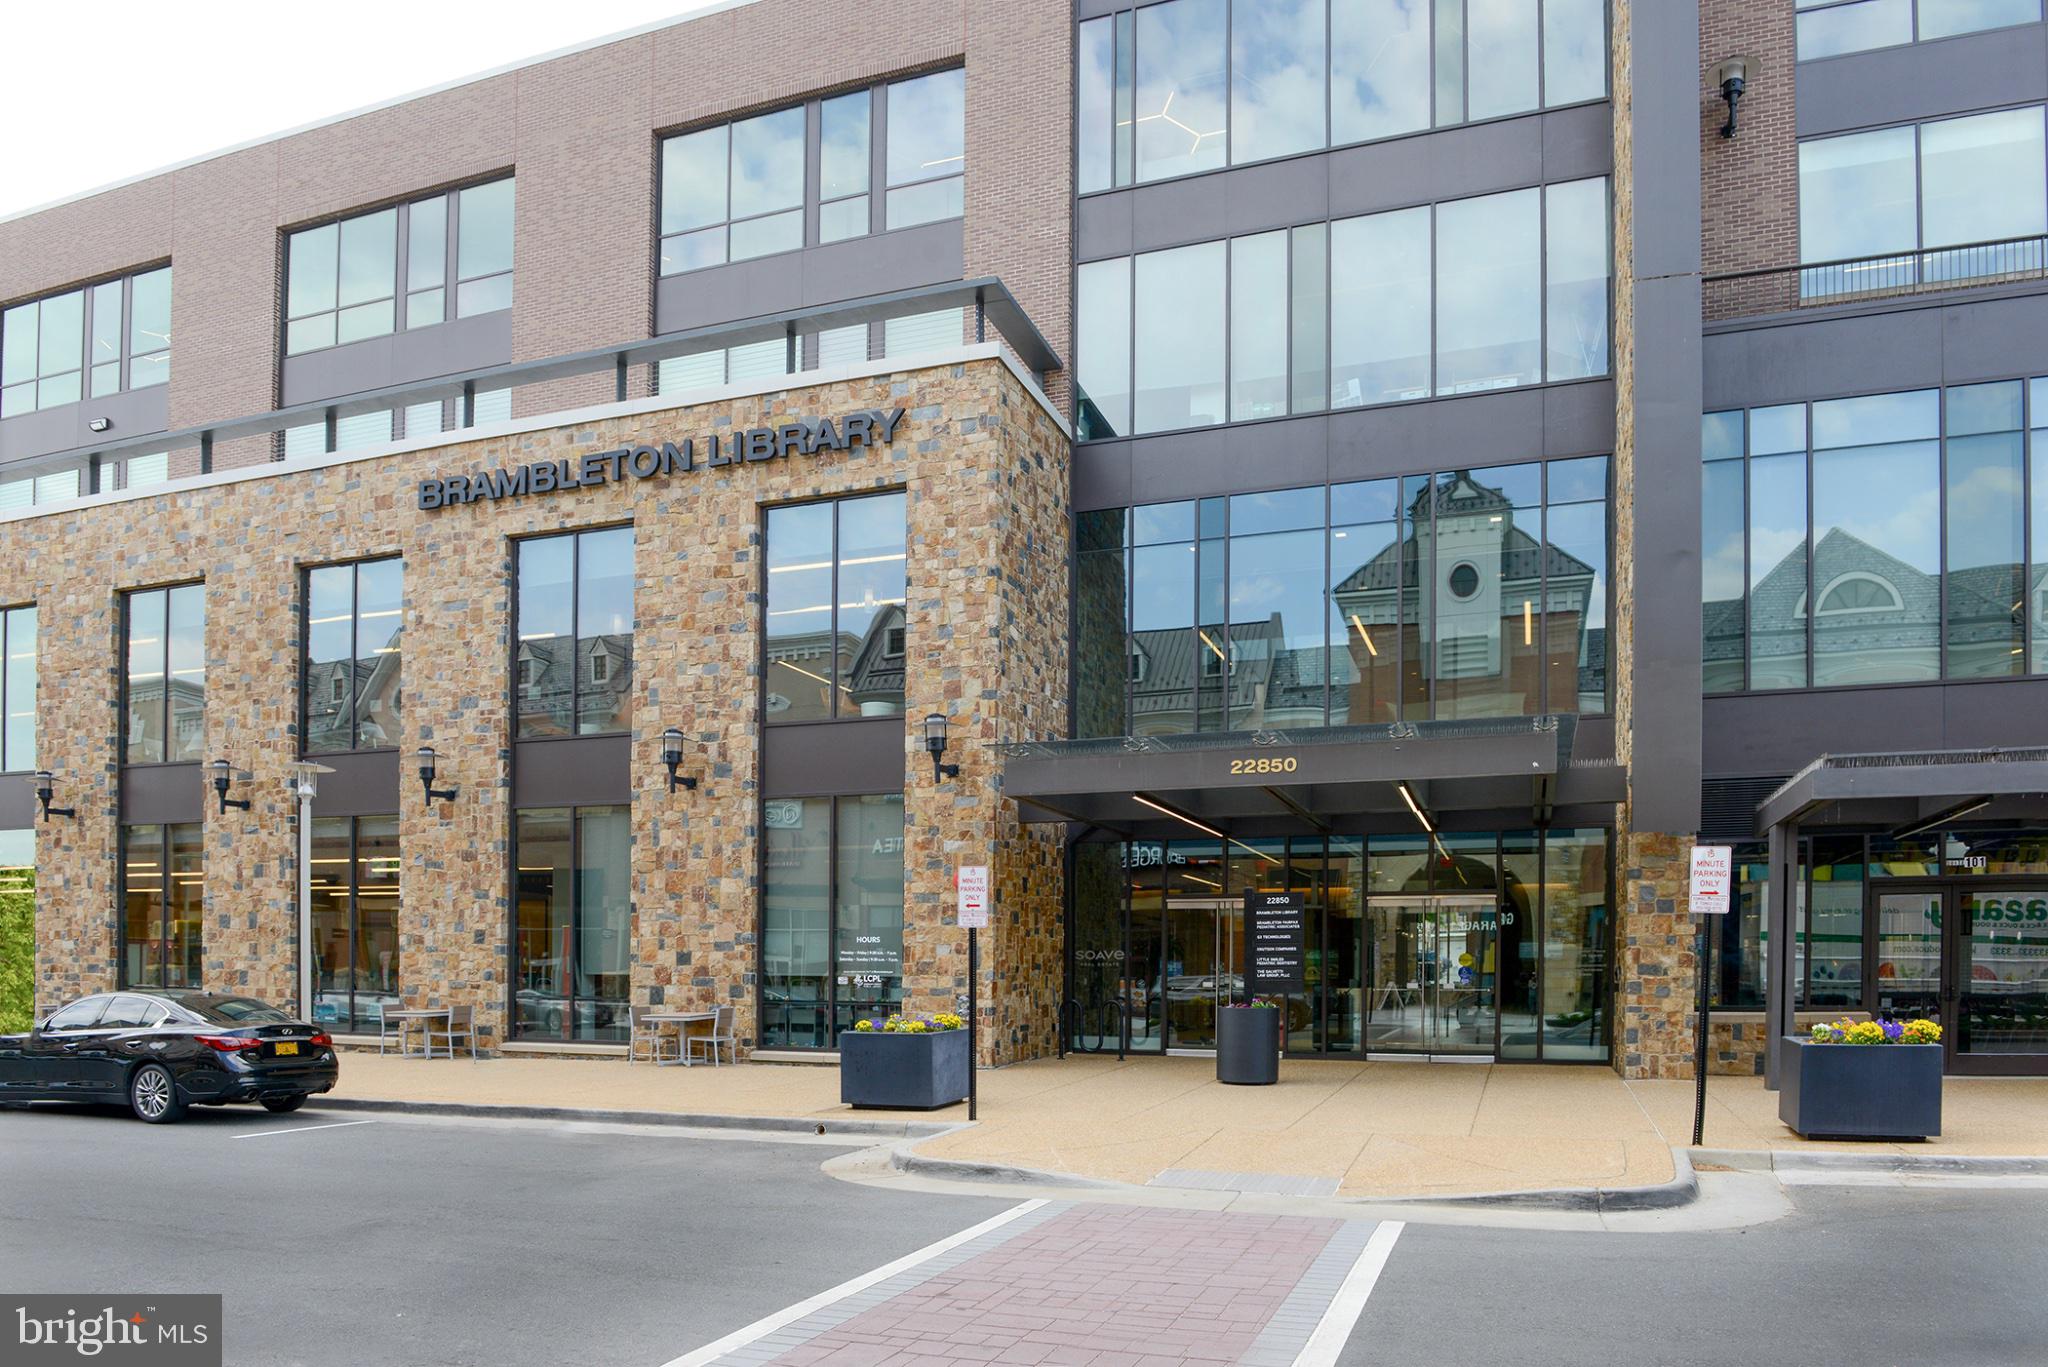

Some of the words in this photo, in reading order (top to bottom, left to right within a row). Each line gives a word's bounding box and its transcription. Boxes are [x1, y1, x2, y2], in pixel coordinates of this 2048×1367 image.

[418, 437, 692, 510] BRAMBLETON
[708, 408, 907, 468] LIBRARY
[1230, 757, 1297, 774] 22850
[1696, 860, 1725, 868] MINUTE
[1965, 857, 1986, 868] 101
[1693, 870, 1727, 878] PARKING
[1266, 896, 1290, 904] 22850
[863, 974, 881, 983] LCPL
